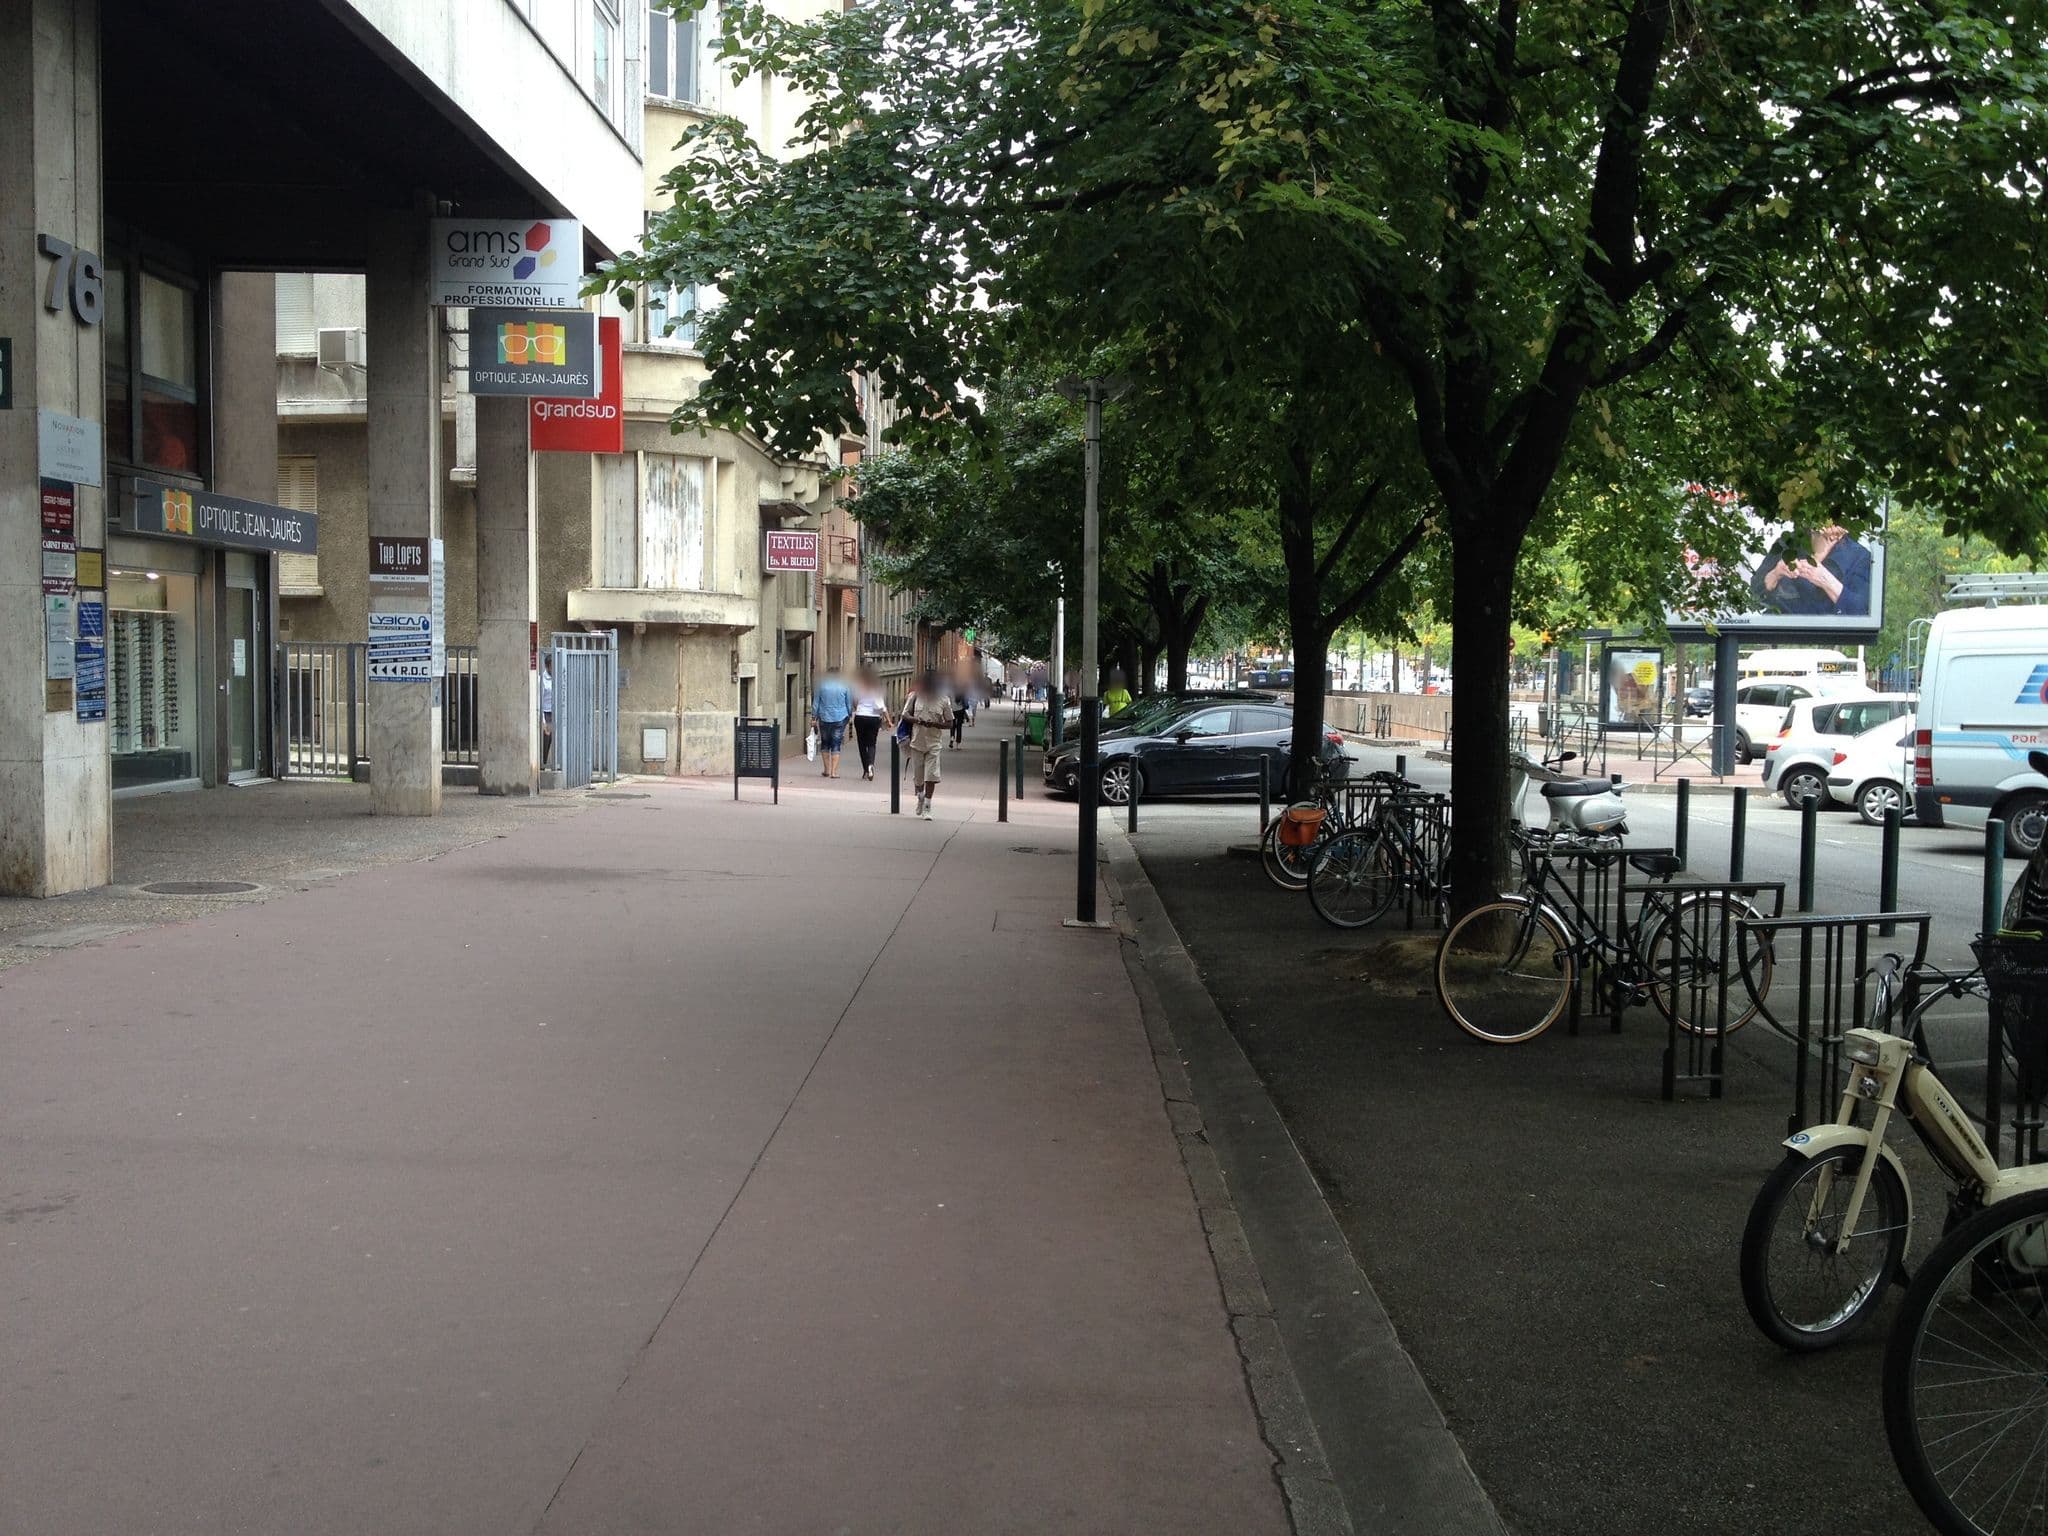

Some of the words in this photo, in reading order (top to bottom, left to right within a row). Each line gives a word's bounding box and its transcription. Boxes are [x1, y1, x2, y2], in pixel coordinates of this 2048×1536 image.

[447, 230, 520, 254] ams
[449, 254, 485, 269] Grand
[490, 254, 510, 269] Sud
[37, 233, 103, 325] 76
[468, 285, 541, 296] FORMATION
[444, 294, 566, 307] PROFESSIONNELLE
[475, 371, 517, 383] OPTIQUE
[519, 371, 590, 386] JEAN-JAURÈS
[200, 505, 241, 534] OPTIQUE
[242, 513, 302, 543] JEAN-JAURÈS
[771, 535, 814, 550] TEXTILES
